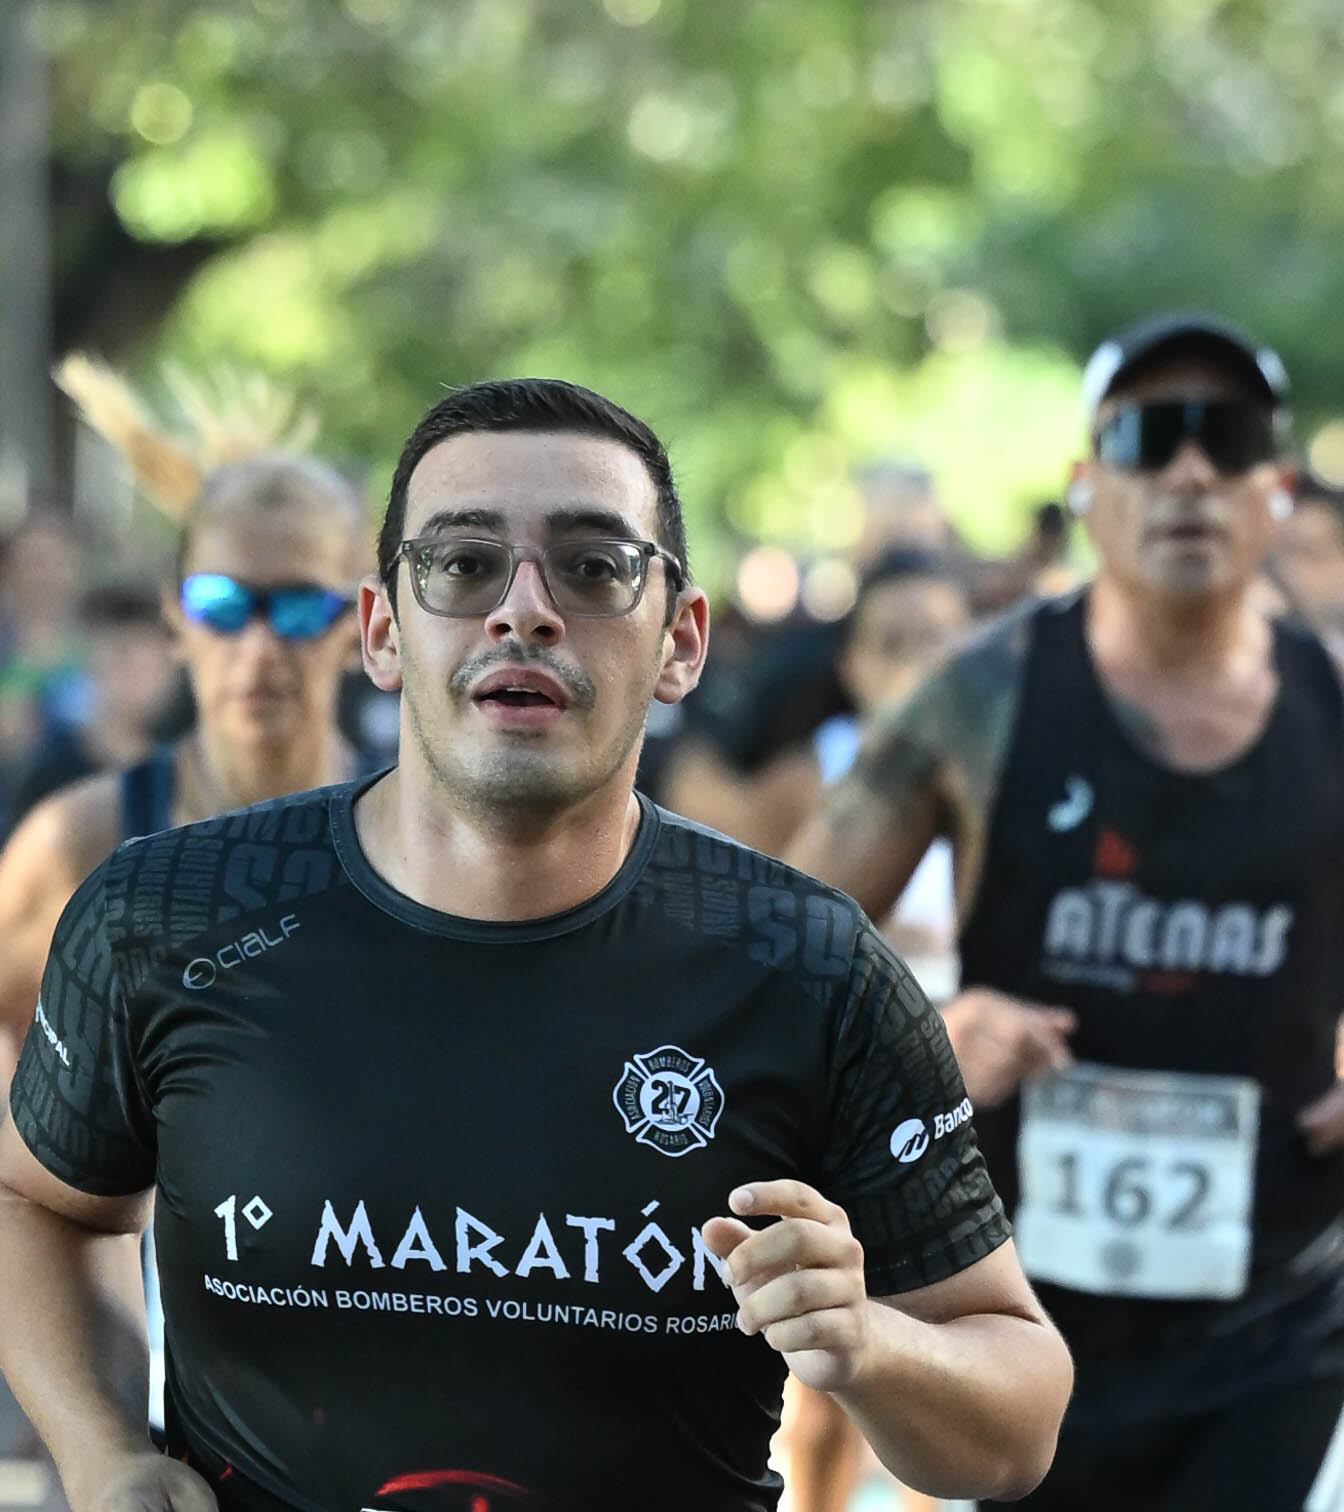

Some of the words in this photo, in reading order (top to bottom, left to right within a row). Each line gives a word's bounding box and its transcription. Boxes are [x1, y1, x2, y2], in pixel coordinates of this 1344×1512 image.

[651, 1079, 691, 1116] 27
[934, 1097, 974, 1140] Banco
[1050, 1150, 1213, 1231] 162
[204, 1274, 328, 1308] ASOCIACIÓN
[335, 1289, 479, 1317] BOMBEROS
[486, 1299, 658, 1333] VOLUNTARIOS
[666, 1313, 740, 1335] ROSARI
